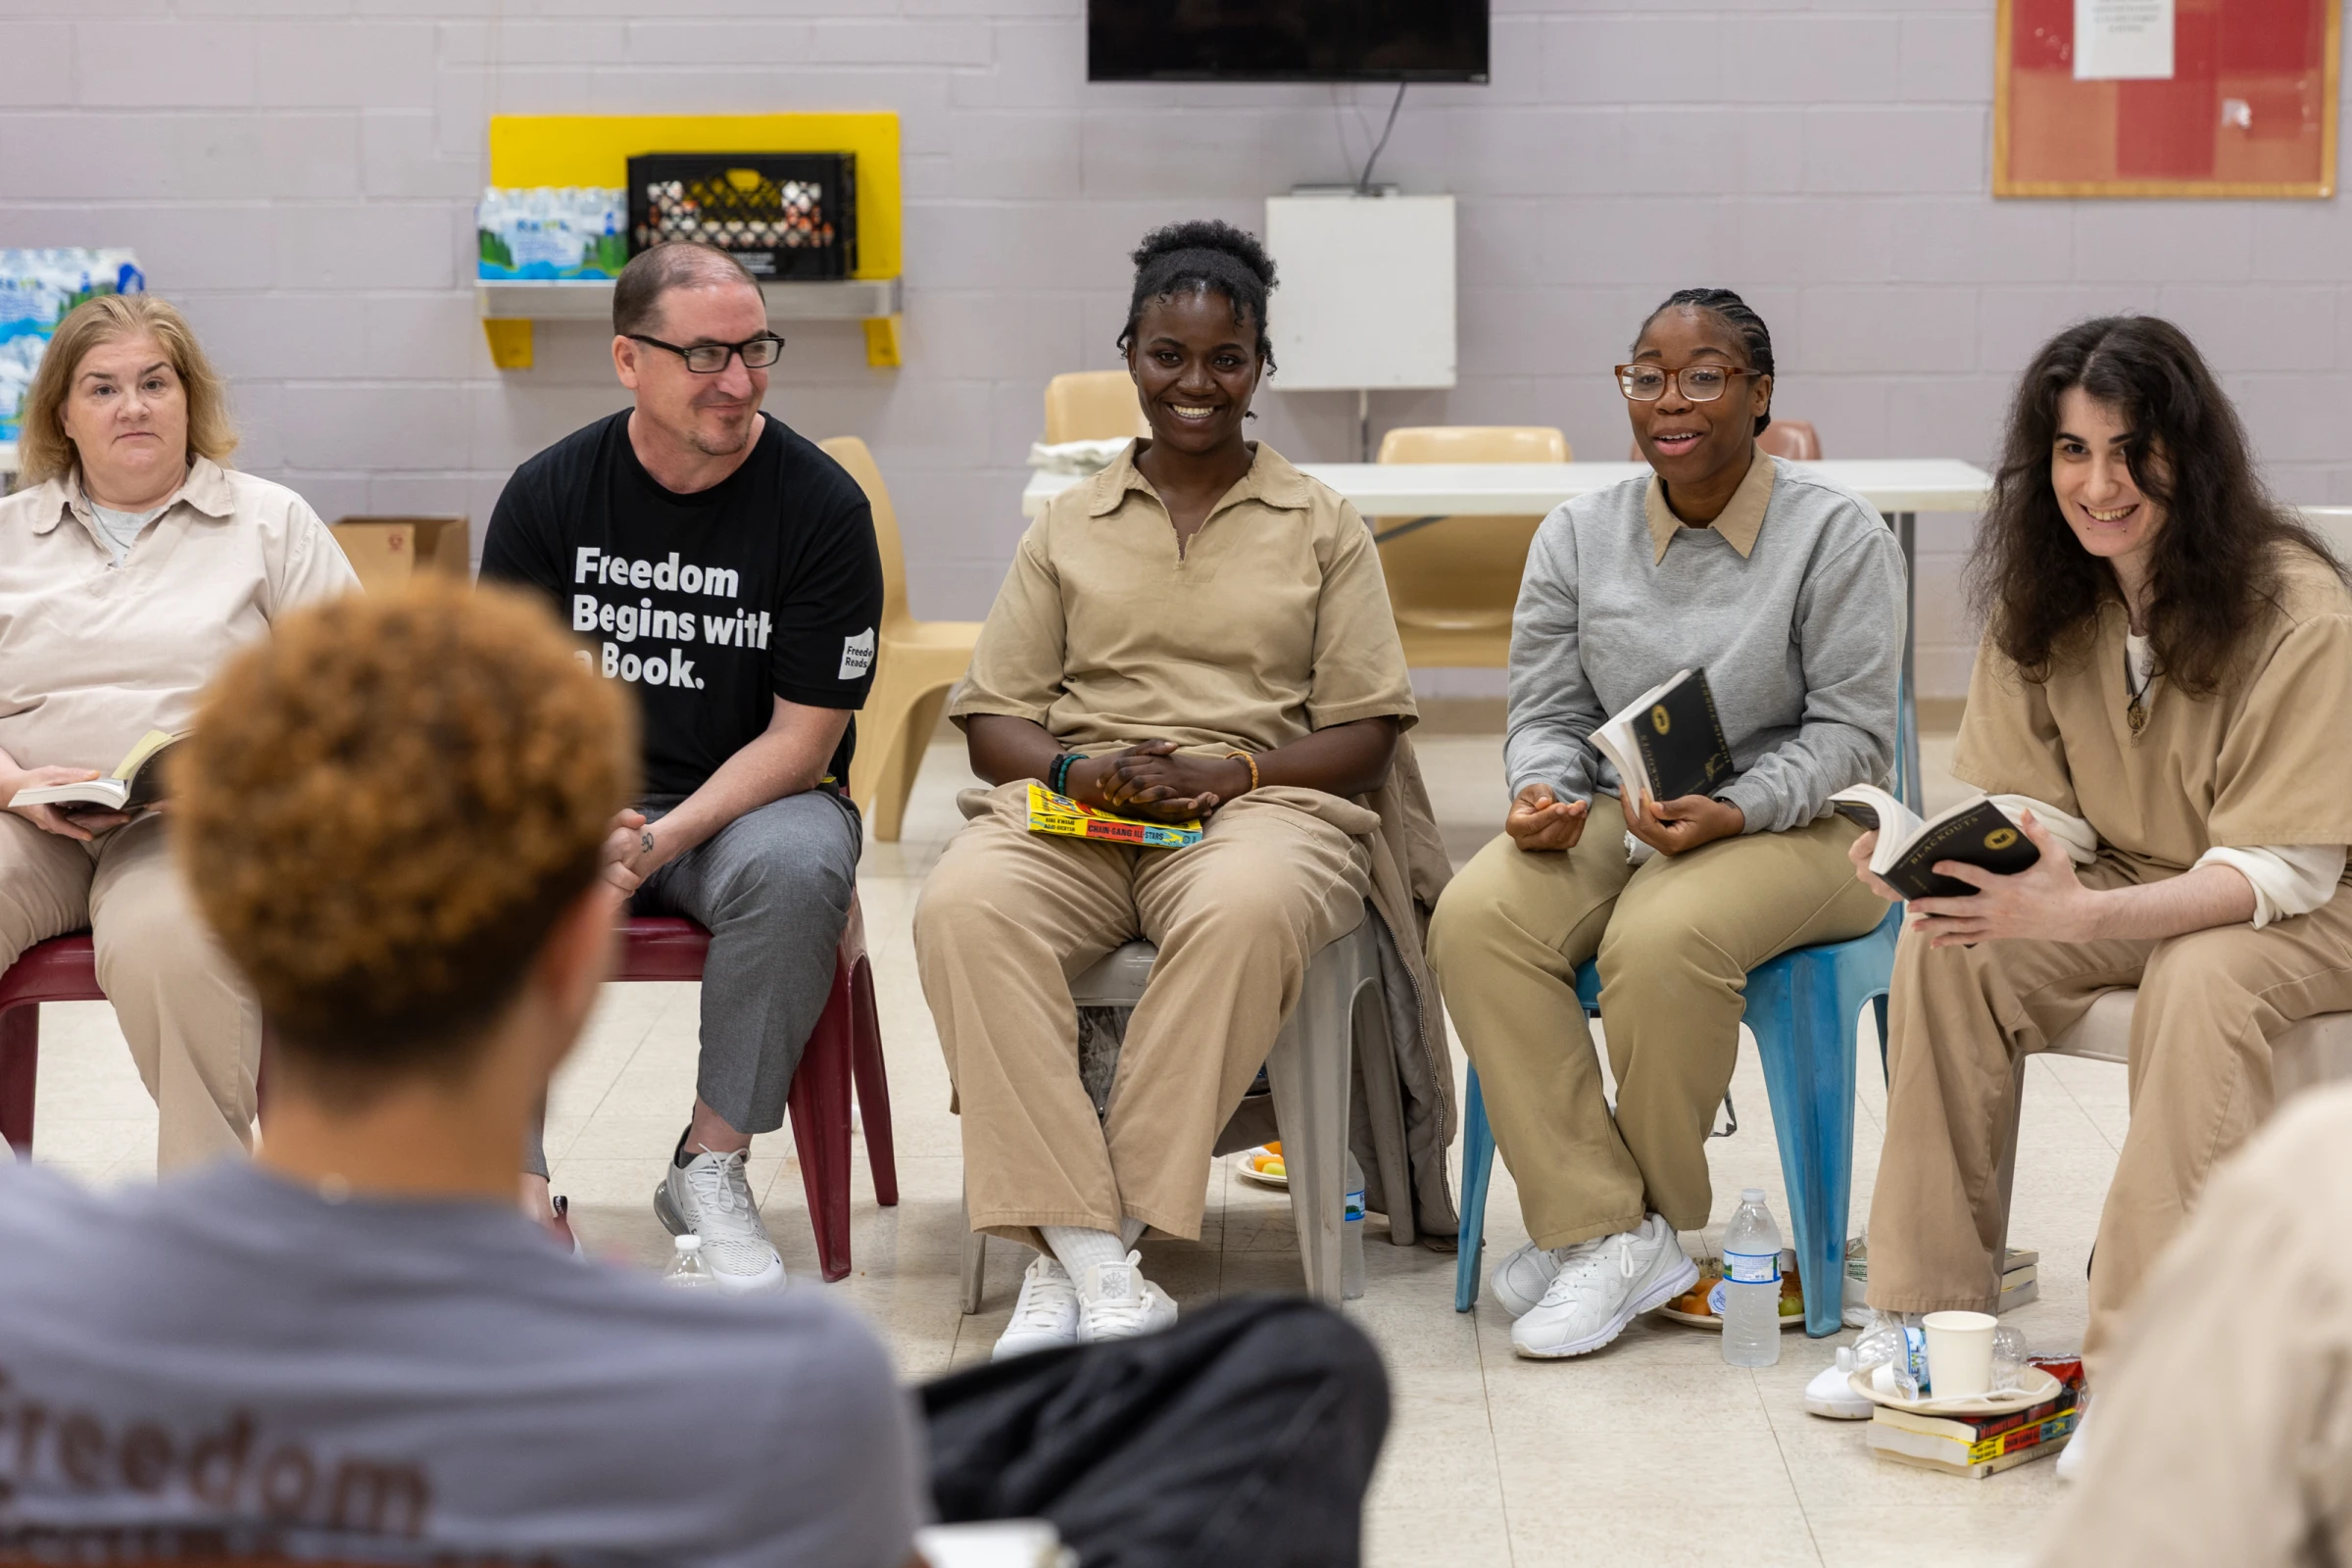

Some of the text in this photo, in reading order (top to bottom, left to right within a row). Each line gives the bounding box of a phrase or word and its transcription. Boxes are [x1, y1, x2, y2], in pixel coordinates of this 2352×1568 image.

[574, 546, 740, 599] Freedom
[572, 594, 696, 643] Begins
[601, 641, 706, 691] Book.
[845, 656, 868, 668] Reads
[1911, 816, 1979, 864] BLACKOUTS
[0, 1365, 431, 1540] reedom
